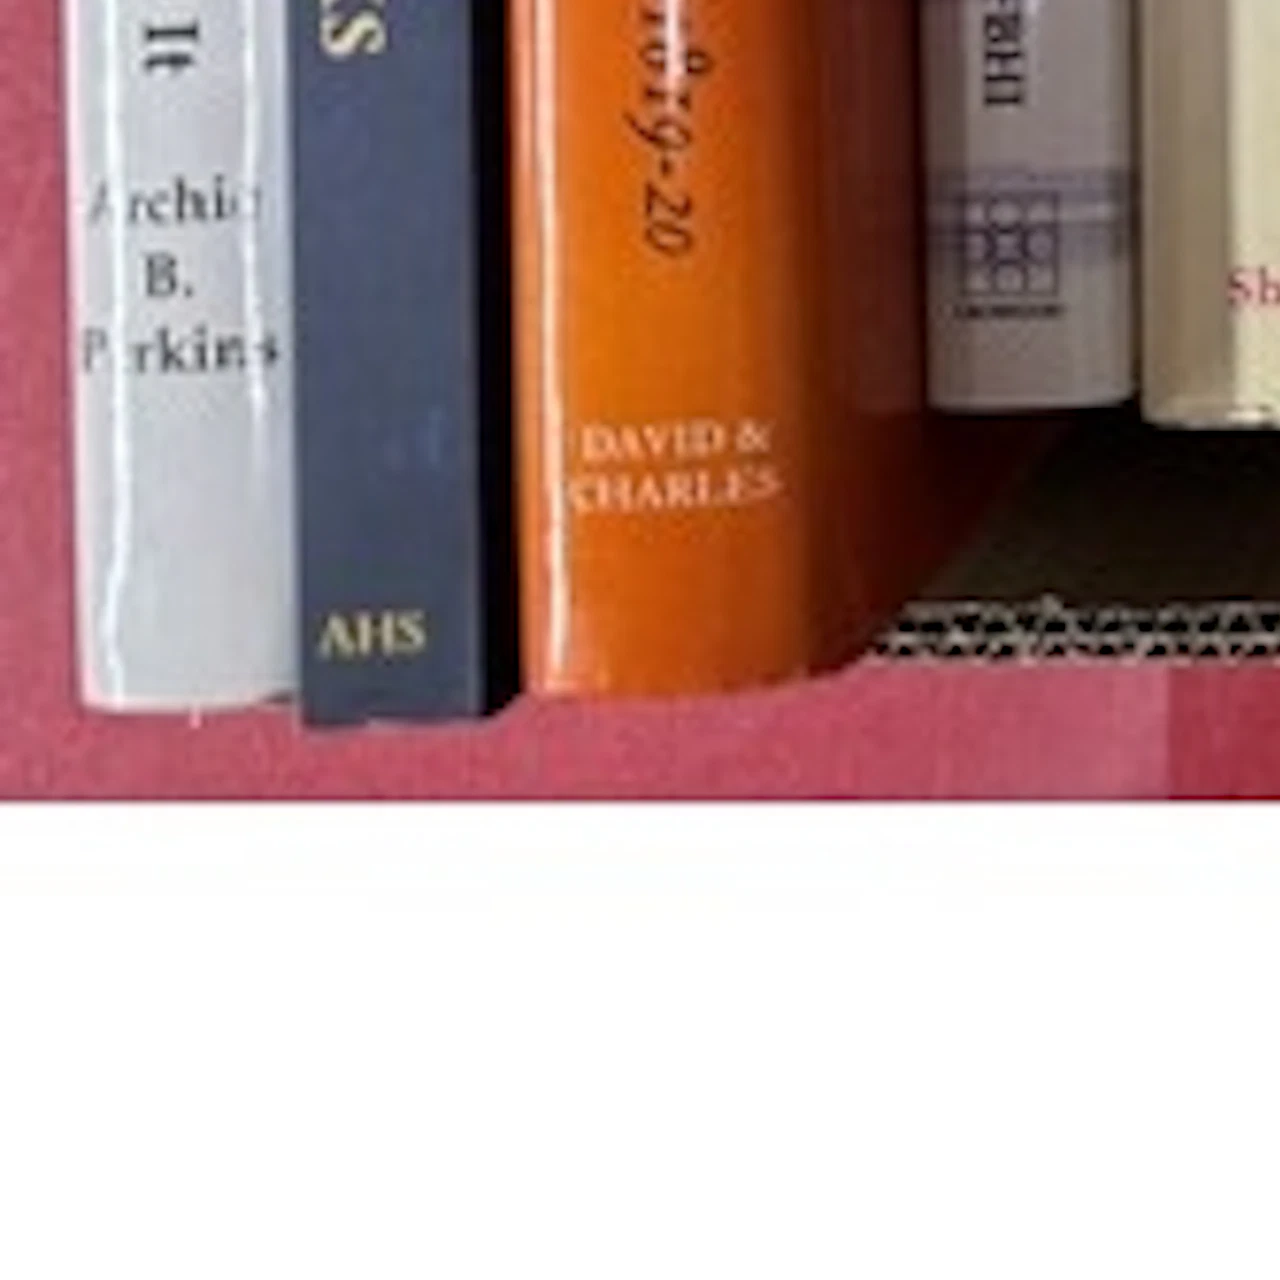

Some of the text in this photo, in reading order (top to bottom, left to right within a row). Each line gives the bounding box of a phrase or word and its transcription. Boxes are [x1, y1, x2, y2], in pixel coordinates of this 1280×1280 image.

[142, 21, 200, 74] It
[145, 254, 194, 299] B.
[83, 327, 279, 374] Prkins
[581, 421, 775, 462] DAVID &
[571, 465, 782, 513] CHARLES
[320, 612, 425, 657] AHS
